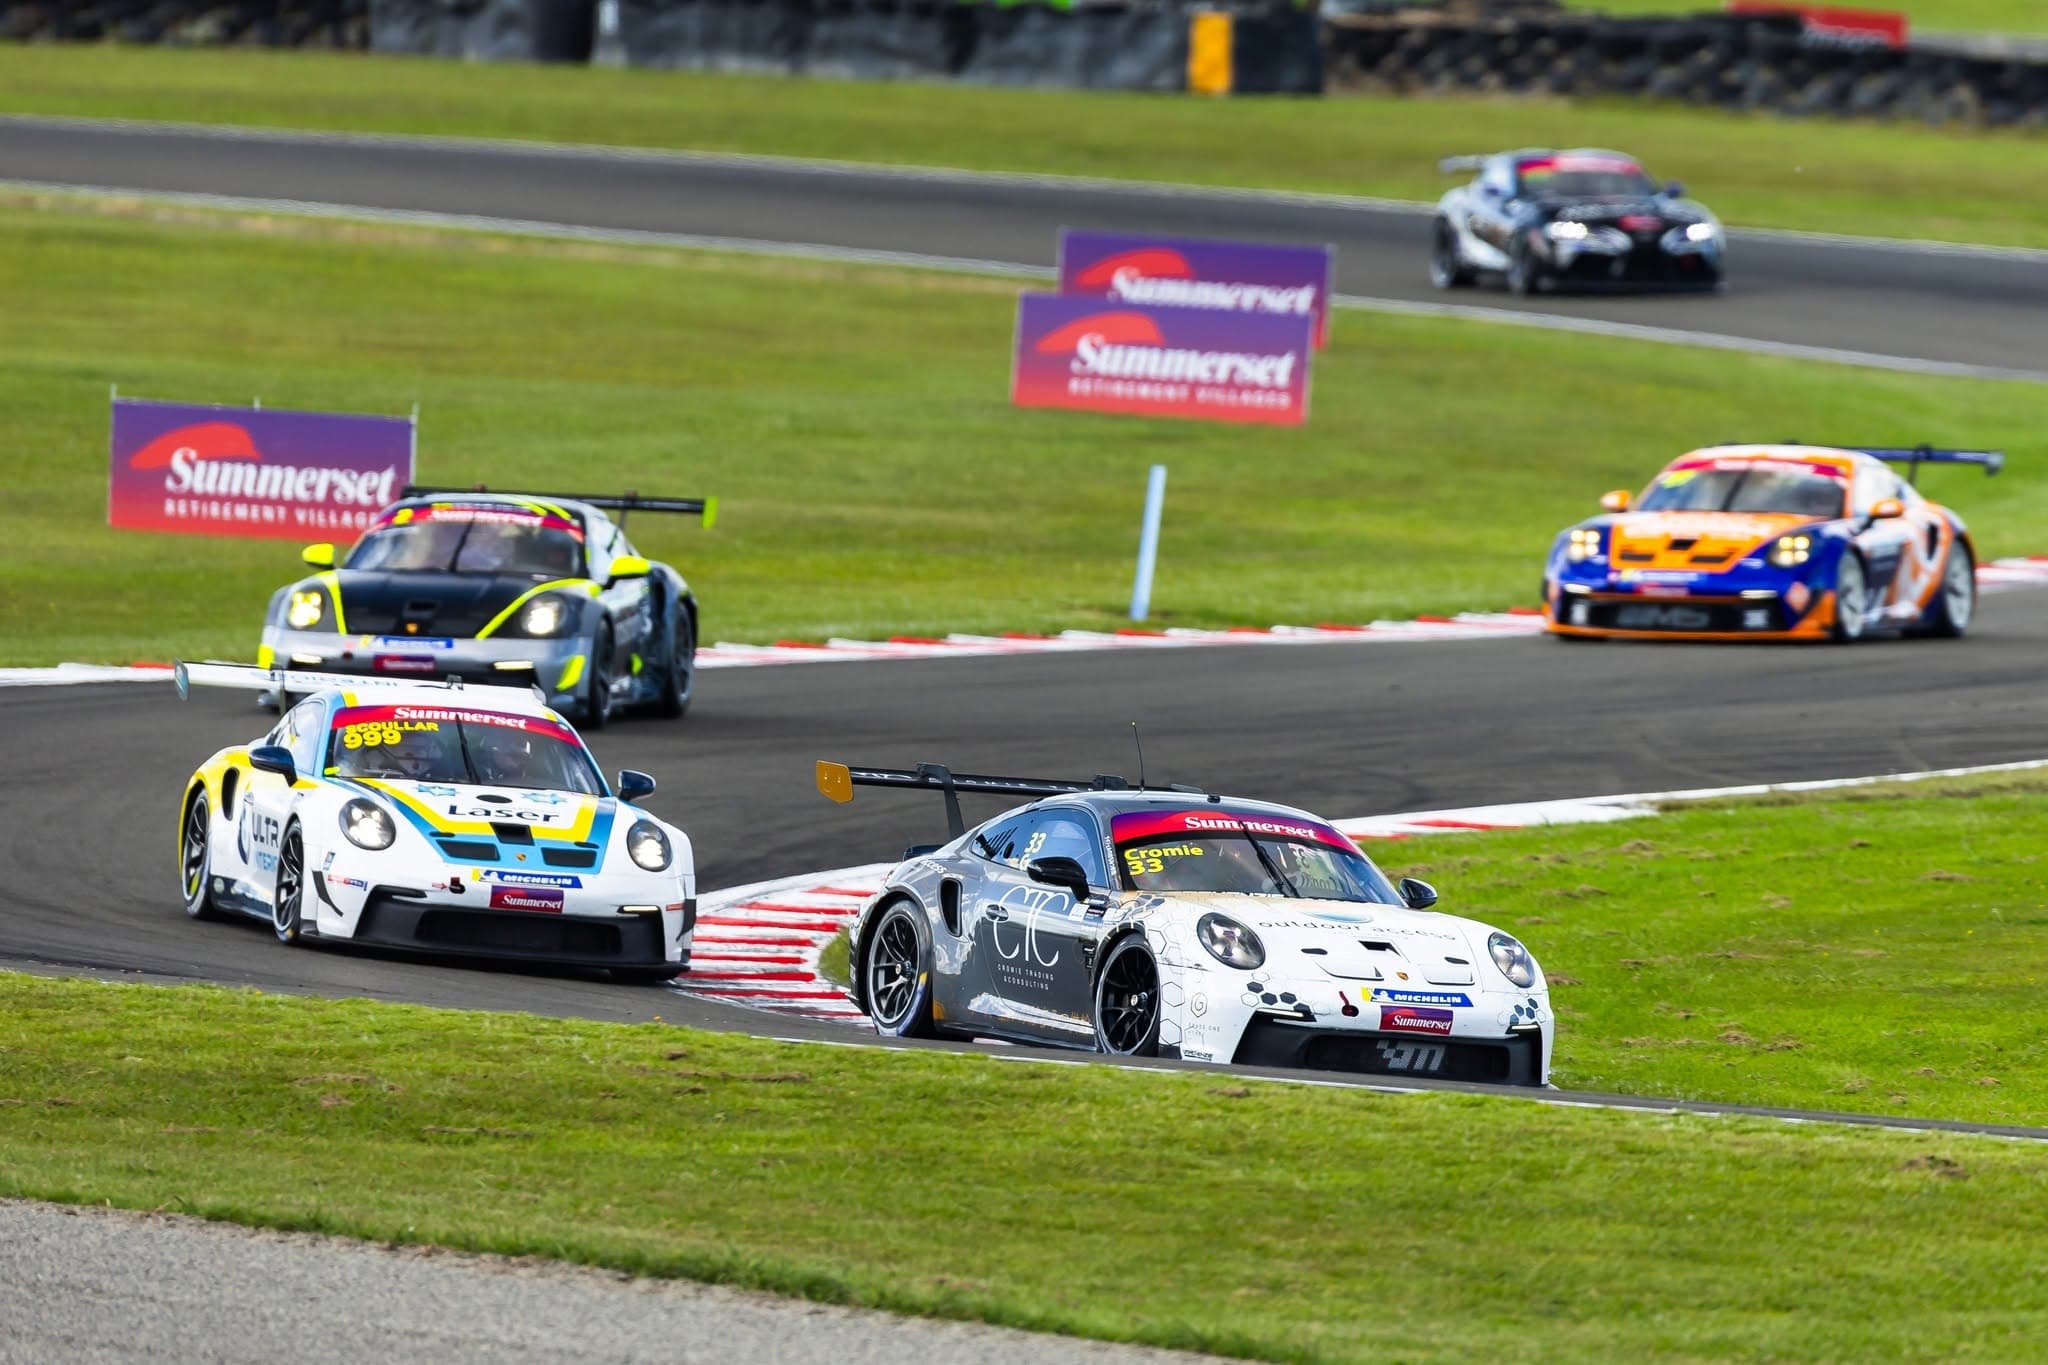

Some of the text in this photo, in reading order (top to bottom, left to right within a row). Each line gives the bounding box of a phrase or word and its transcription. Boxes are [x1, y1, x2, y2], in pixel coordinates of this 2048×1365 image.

[1107, 265, 1316, 315] Summerset
[1070, 332, 1295, 388] Summerset
[165, 447, 396, 507] Summerset
[164, 498, 379, 530] RETIREMENT VILLAGE
[393, 707, 528, 730] Summerset
[345, 721, 439, 737] SCOULLAR
[343, 730, 402, 750] 999
[448, 804, 560, 823] Laser
[251, 812, 279, 849] ULTR
[1184, 816, 1317, 840] Summerset
[1024, 832, 1047, 853] 33
[1124, 844, 1204, 862] Cromie
[1128, 858, 1165, 876] 33
[503, 874, 572, 886] MICHELIN
[502, 894, 562, 910] Summerset
[1258, 921, 1456, 941] outdoor access
[997, 963, 1054, 982] CROMIE TRADING
[1394, 994, 1462, 1004] MICHELIN
[1392, 1014, 1452, 1031] Summerset
